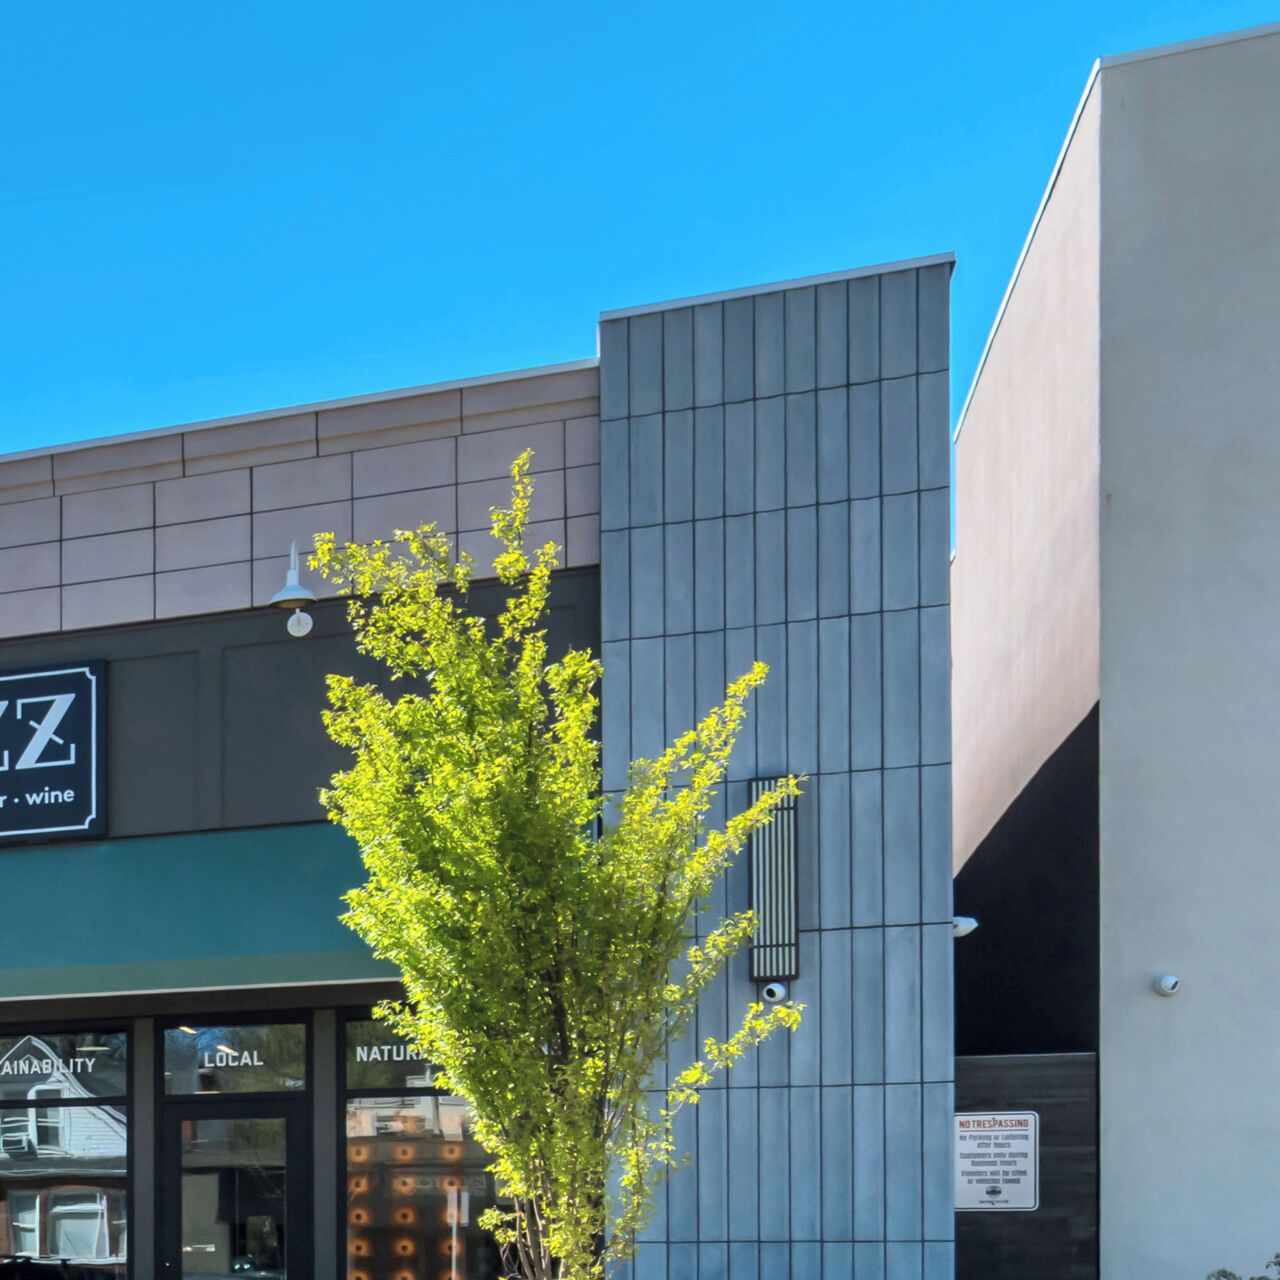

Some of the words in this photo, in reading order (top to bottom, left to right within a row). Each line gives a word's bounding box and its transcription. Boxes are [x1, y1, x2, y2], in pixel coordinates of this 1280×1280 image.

[25, 786, 76, 806] wine
[203, 1050, 264, 1069] LOCAL
[355, 1045, 424, 1063] NATUR
[959, 1120, 971, 1129] NO
[971, 1119, 1029, 1129] TRESPASSING
